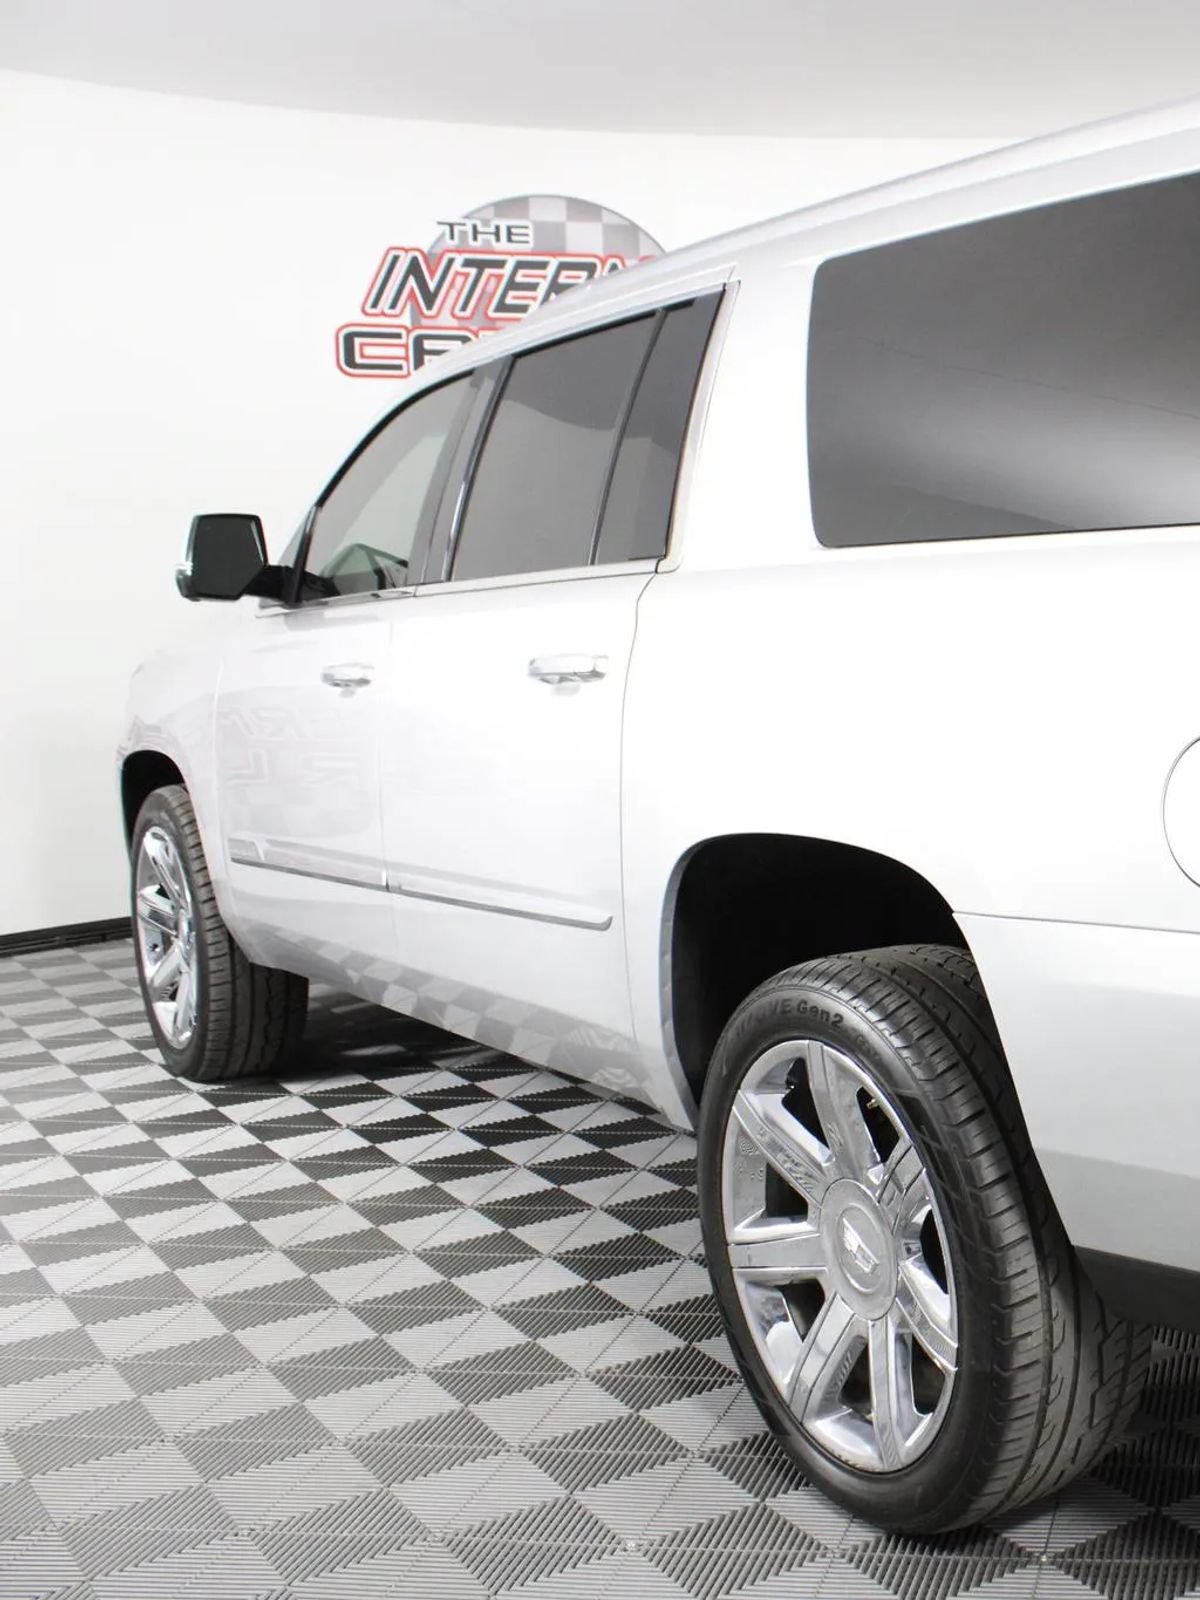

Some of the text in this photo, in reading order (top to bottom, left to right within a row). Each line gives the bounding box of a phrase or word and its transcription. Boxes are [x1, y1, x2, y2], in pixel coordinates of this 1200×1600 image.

[437, 221, 531, 244] THE
[368, 252, 624, 316] INTER
[797, 998, 844, 1028] Gen2
